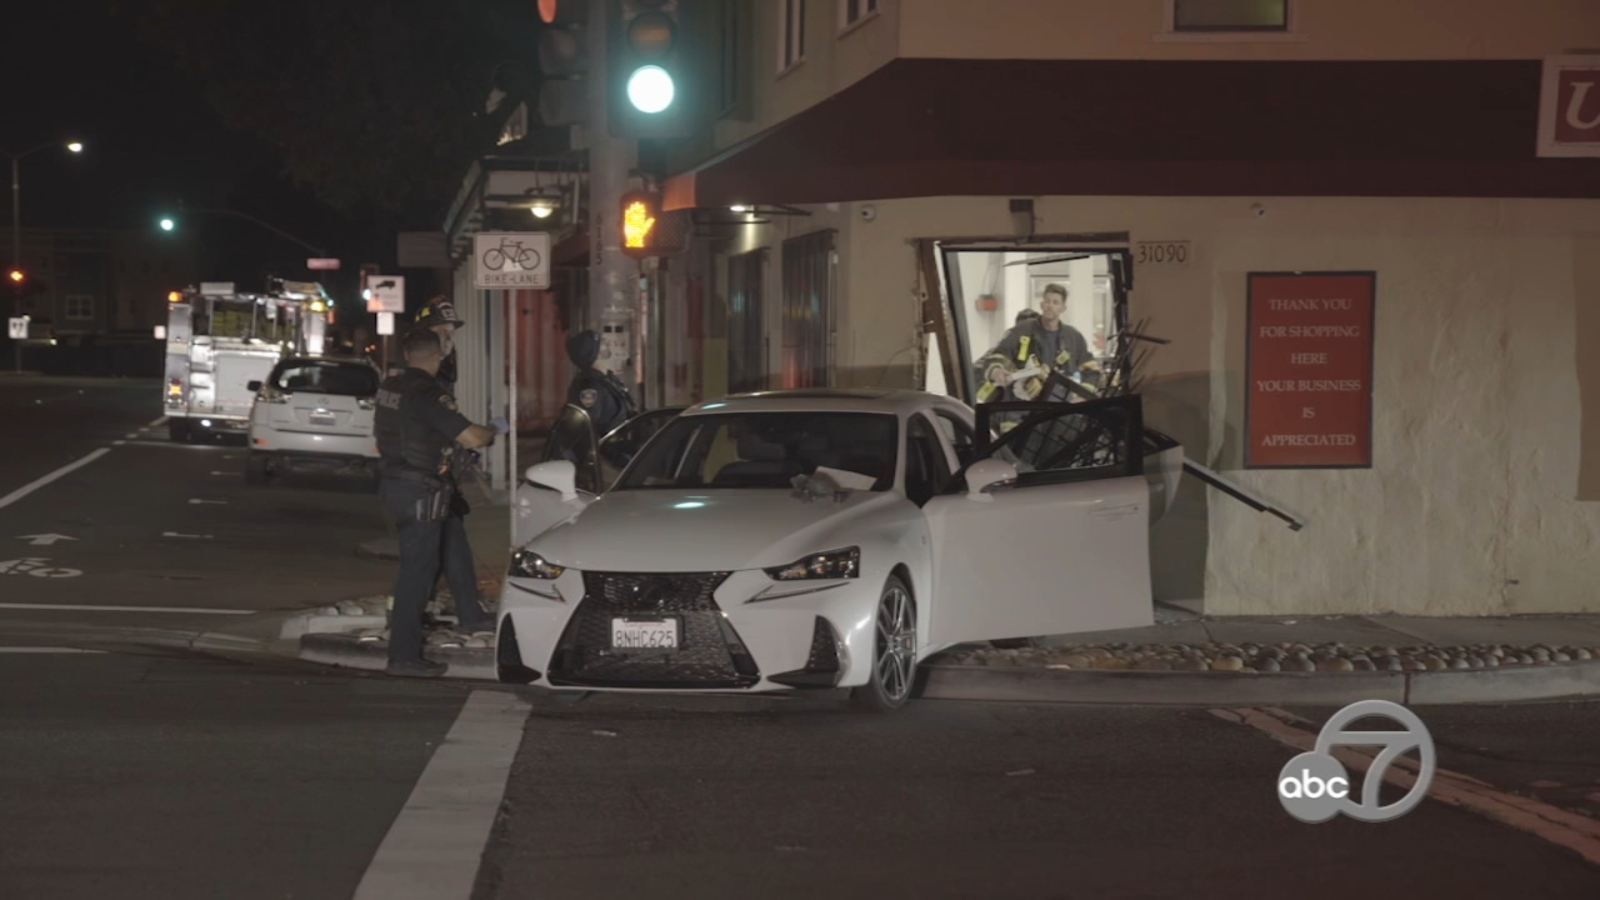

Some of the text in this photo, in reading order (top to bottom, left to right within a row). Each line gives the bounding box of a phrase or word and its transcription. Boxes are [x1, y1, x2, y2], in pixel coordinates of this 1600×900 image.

[1138, 244, 1187, 263] 31090
[1269, 299, 1352, 311] THANK YOU
[1260, 325, 1360, 338] FOR SHOPPING
[1291, 352, 1328, 365] HERE
[1257, 379, 1362, 392] YOUR BUSINESS
[1302, 406, 1316, 419] IS
[1262, 434, 1357, 446] APPRECIATED
[614, 630, 675, 647] 8NHC625
